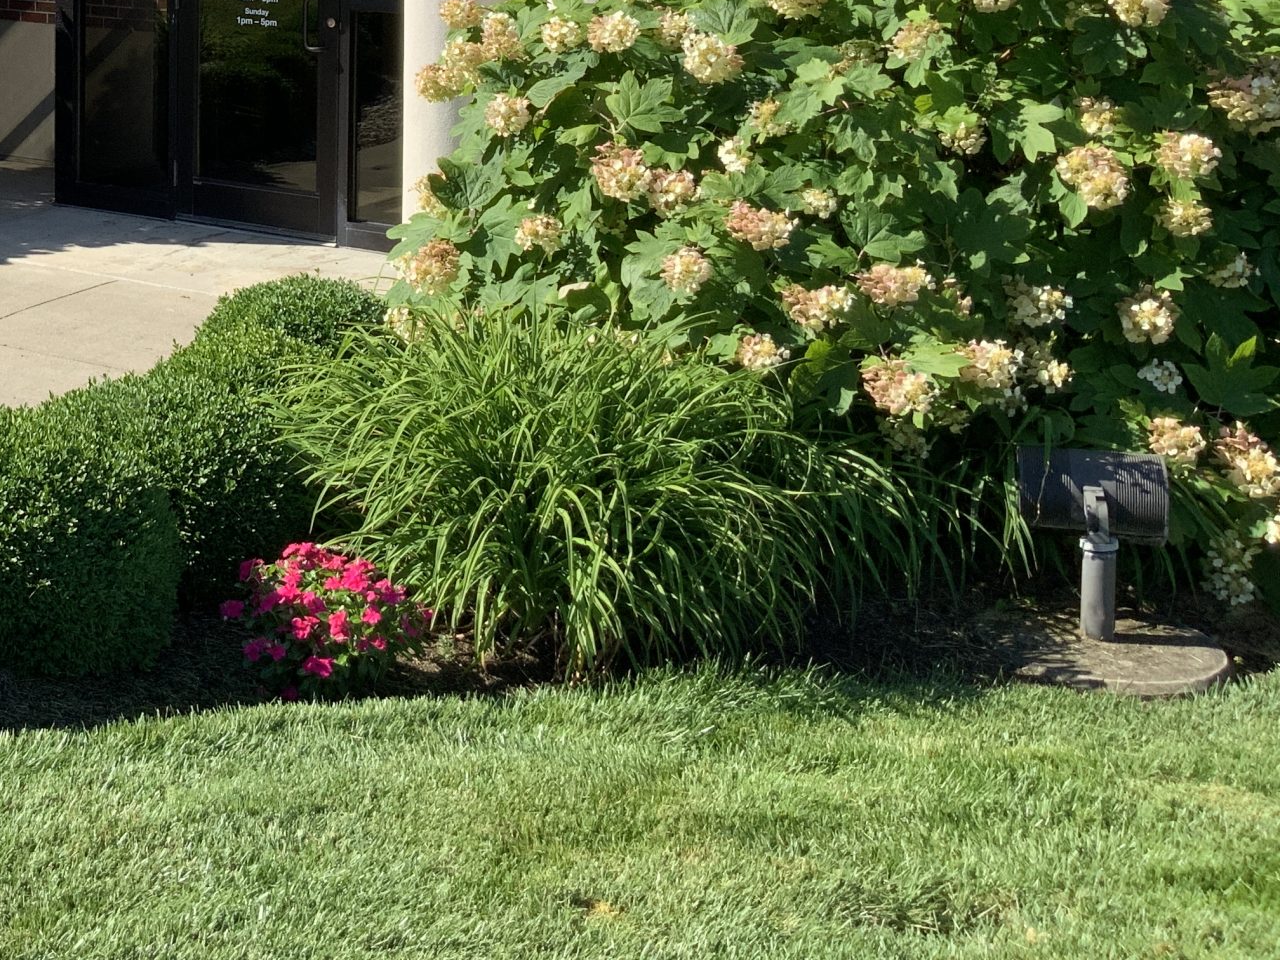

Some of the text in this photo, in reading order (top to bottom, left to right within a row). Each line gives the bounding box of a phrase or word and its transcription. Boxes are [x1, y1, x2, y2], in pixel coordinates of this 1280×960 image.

[244, 7, 269, 17] Sunday
[236, 16, 253, 25] 1pm
[260, 18, 277, 27] 5pm
